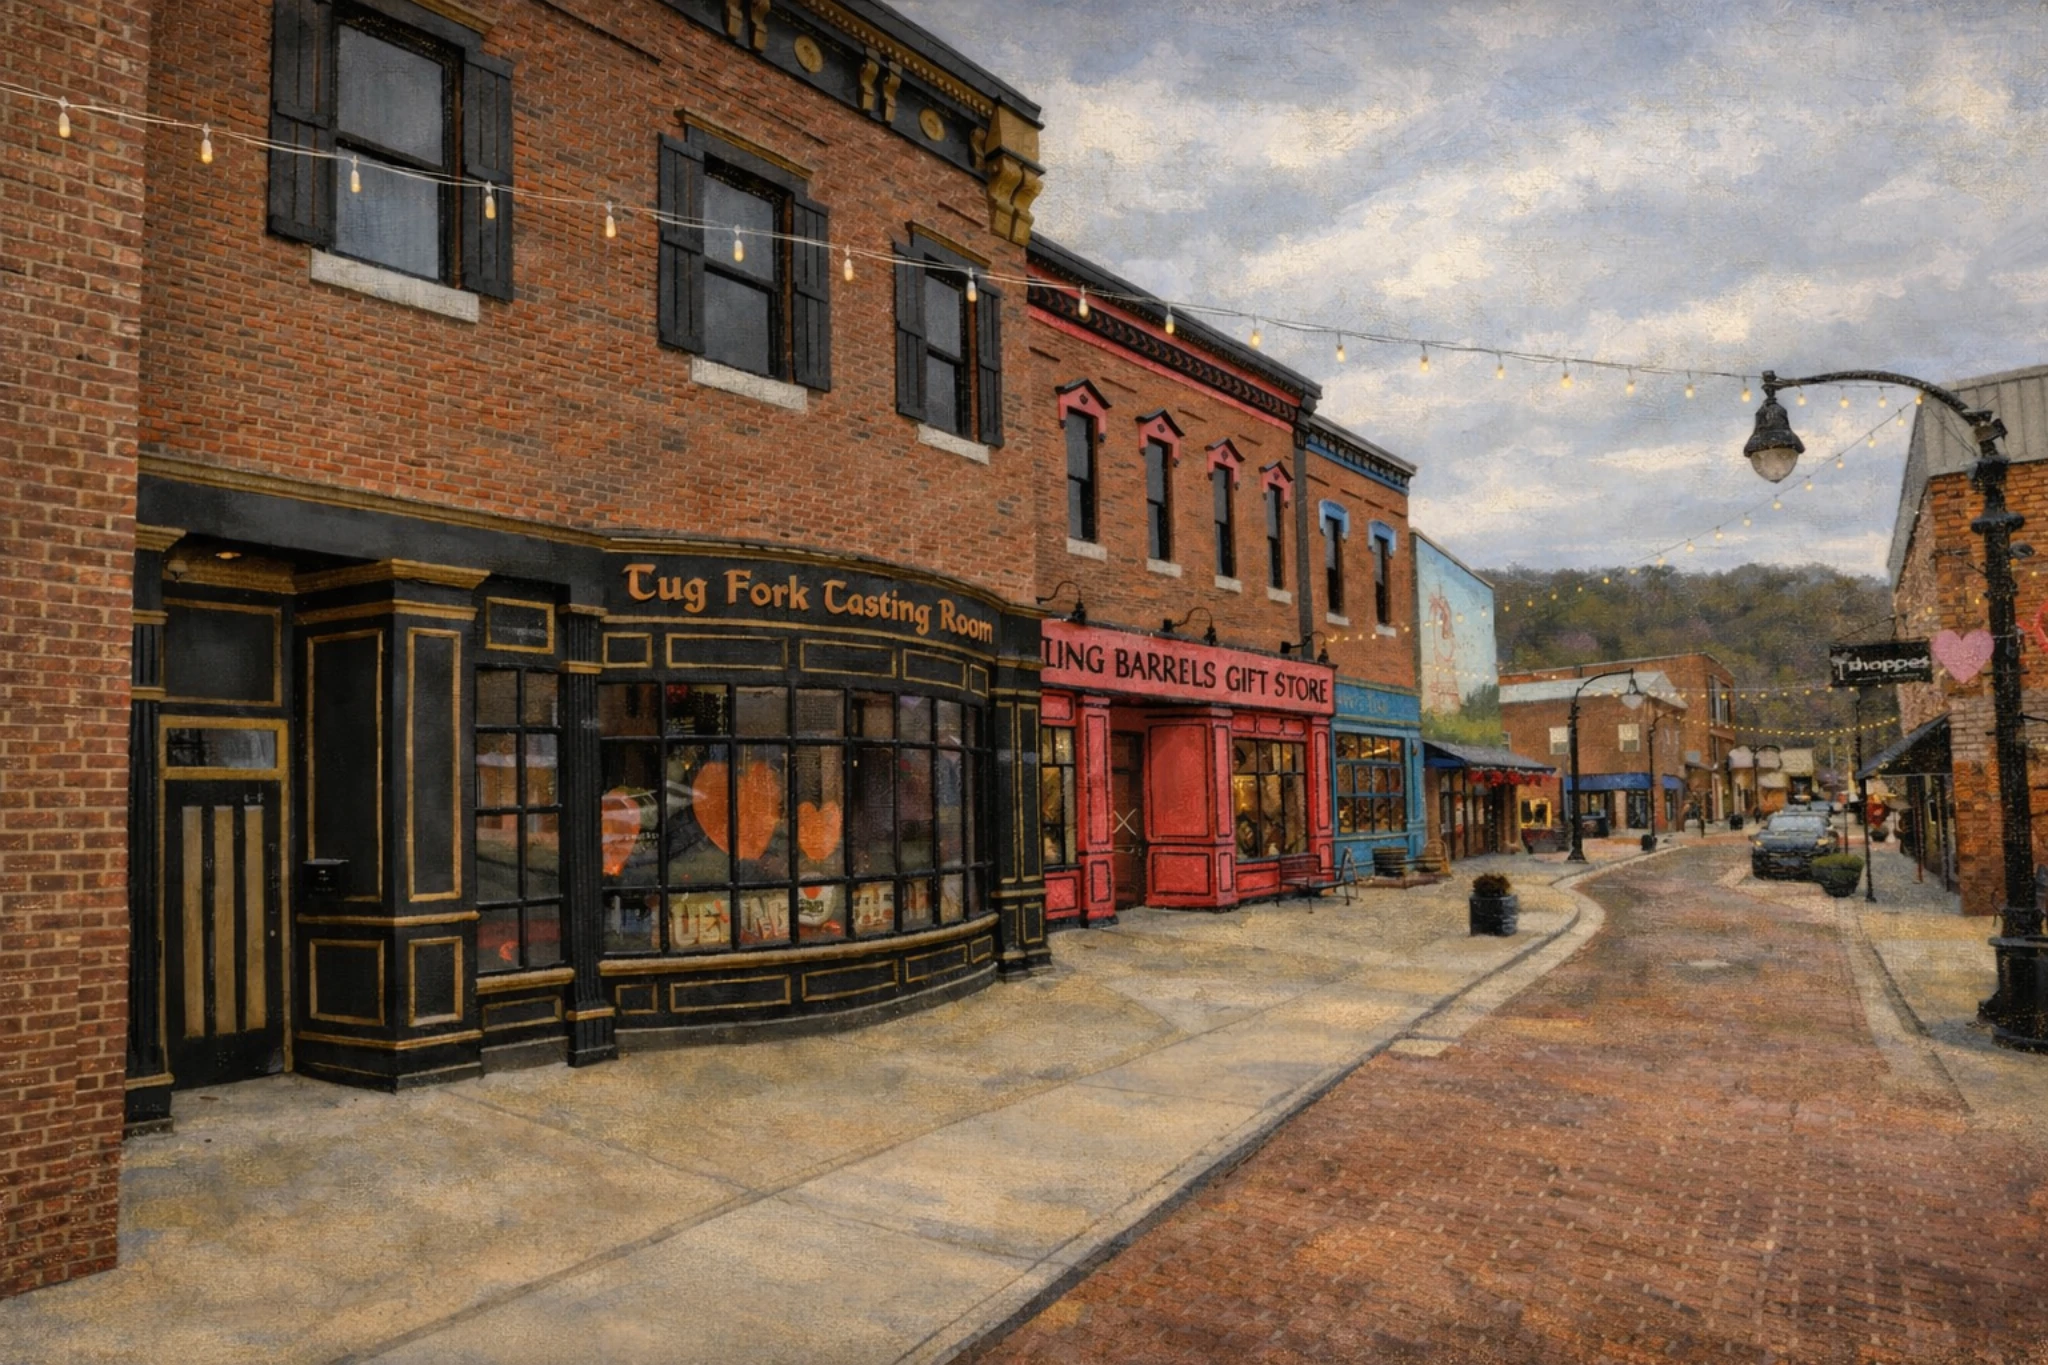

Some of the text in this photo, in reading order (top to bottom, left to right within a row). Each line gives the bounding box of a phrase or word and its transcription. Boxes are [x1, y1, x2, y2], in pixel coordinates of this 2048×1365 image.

[622, 563, 993, 644] Tug Fork Tasting Room
[1114, 648, 1216, 689] BARRELS
[1226, 665, 1269, 696] GIFT
[1275, 672, 1328, 704] STORE
